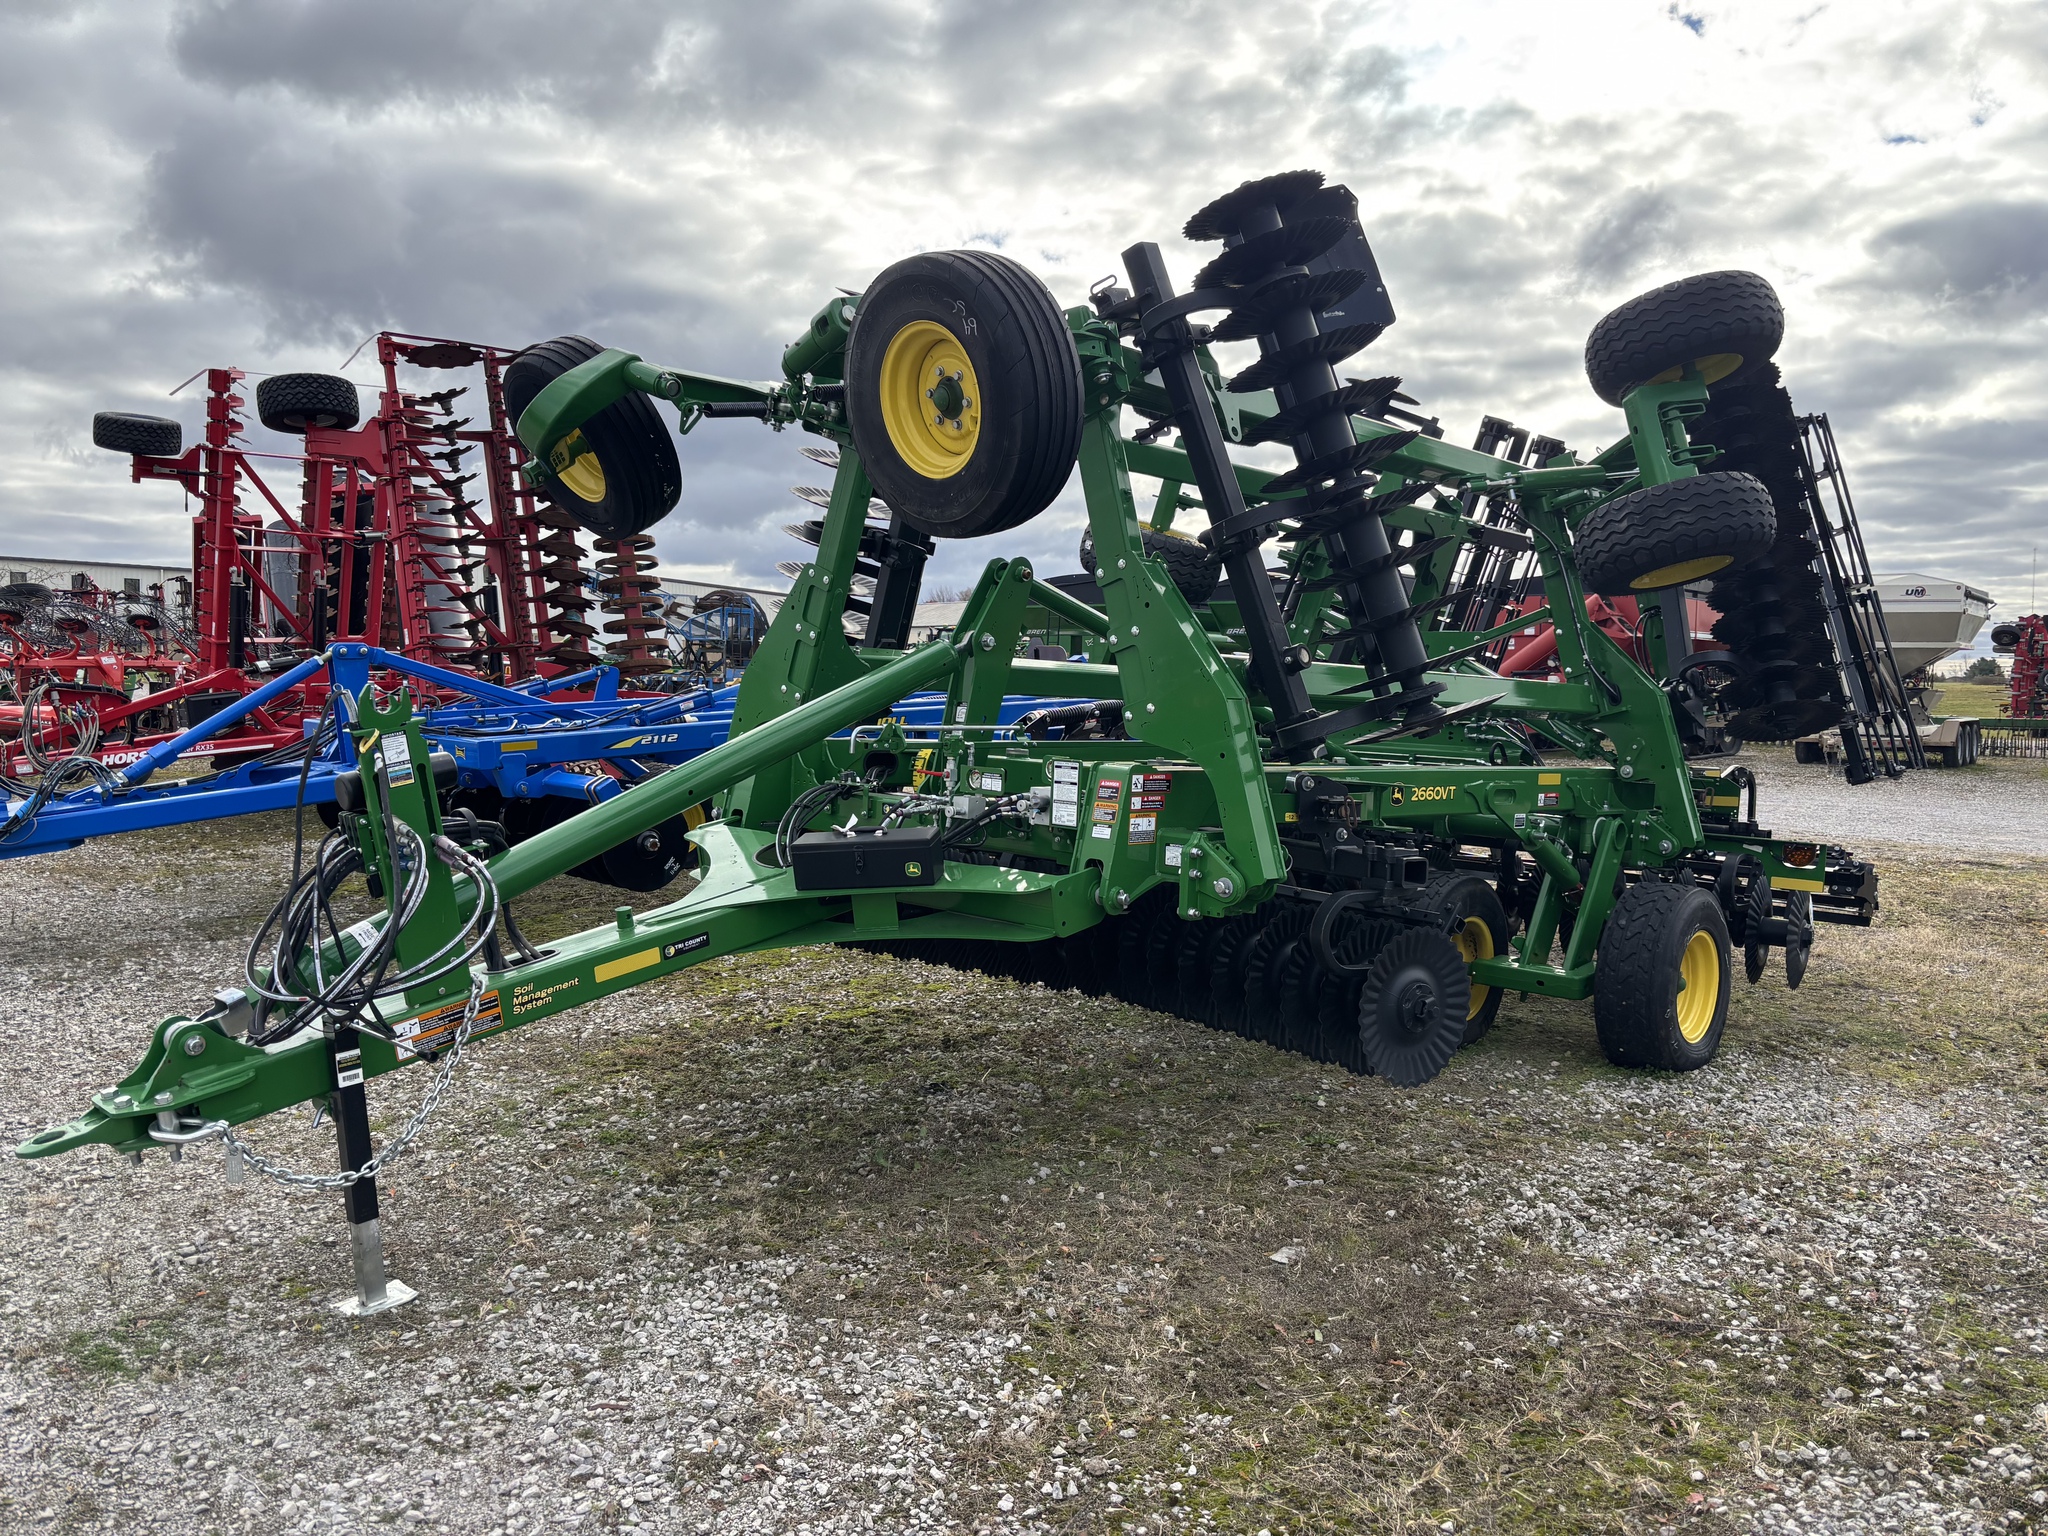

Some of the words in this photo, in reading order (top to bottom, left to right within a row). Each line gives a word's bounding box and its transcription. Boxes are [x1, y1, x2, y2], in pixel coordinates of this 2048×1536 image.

[1905, 587, 1926, 597] UM
[640, 733, 679, 745] 2112
[195, 743, 215, 752] RX35
[101, 750, 149, 766] HORS
[1411, 785, 1457, 801] 2660VT
[674, 942, 685, 951] TRI
[684, 934, 708, 947] COUNTY
[512, 977, 580, 1006] Management
[513, 982, 534, 996] Soil
[512, 995, 552, 1015] System
